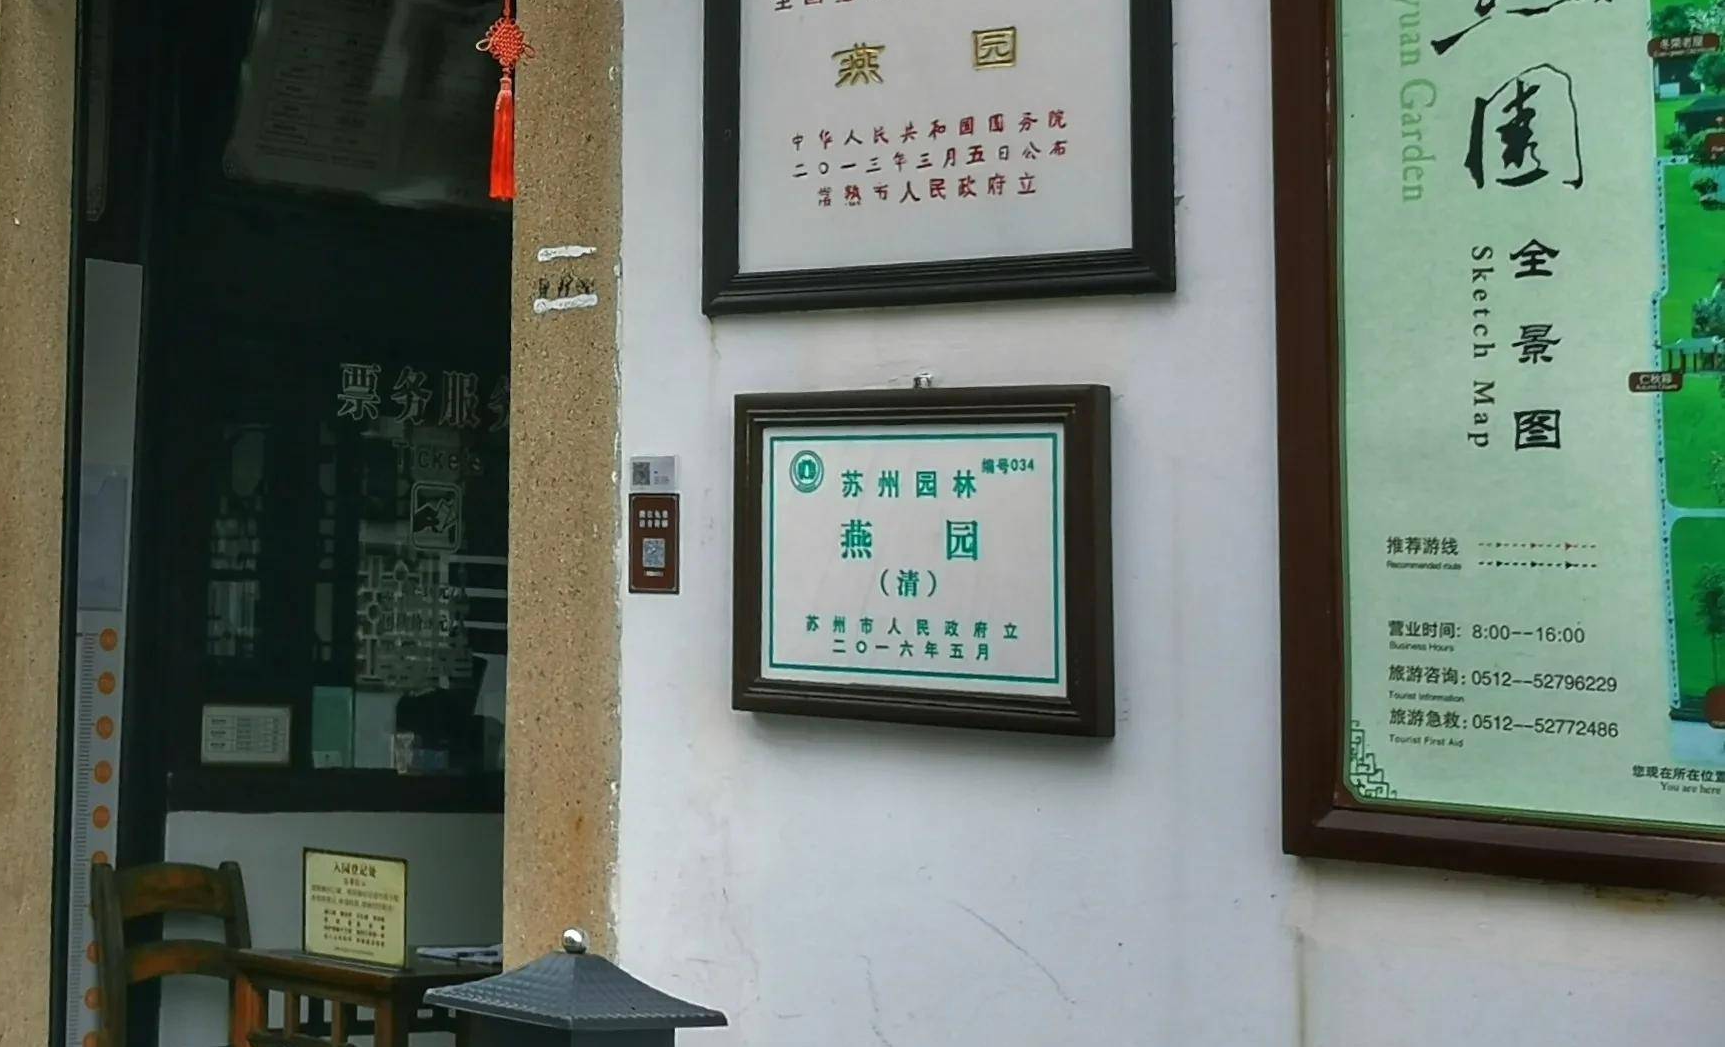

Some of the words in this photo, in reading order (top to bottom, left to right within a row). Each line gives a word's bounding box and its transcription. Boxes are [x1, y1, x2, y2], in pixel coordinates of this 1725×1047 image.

[831, 25, 1018, 89] 燕园
[1399, 78, 1437, 202] Garden
[817, 171, 1037, 206] 常熟市人民政府立
[1471, 245, 1496, 358] Sketch
[1509, 238, 1562, 451] 全景图
[1467, 380, 1495, 448] Map
[981, 457, 1035, 474] 编号034
[841, 469, 977, 499] 苏州园林
[840, 519, 978, 561] 燕园
[1386, 536, 1459, 556] 推荐游线
[805, 614, 1019, 640] 苏州市人民政府立
[1389, 641, 1427, 651] Business
[1429, 642, 1455, 652] Hours
[1388, 690, 1417, 700] Tourist
[1389, 733, 1422, 744] Tourist
[1424, 736, 1446, 746] First
[1632, 765, 1725, 784] 您现在所在位置
[1660, 781, 1680, 792] You
[1682, 785, 1698, 793] are
[1700, 784, 1722, 795] here
